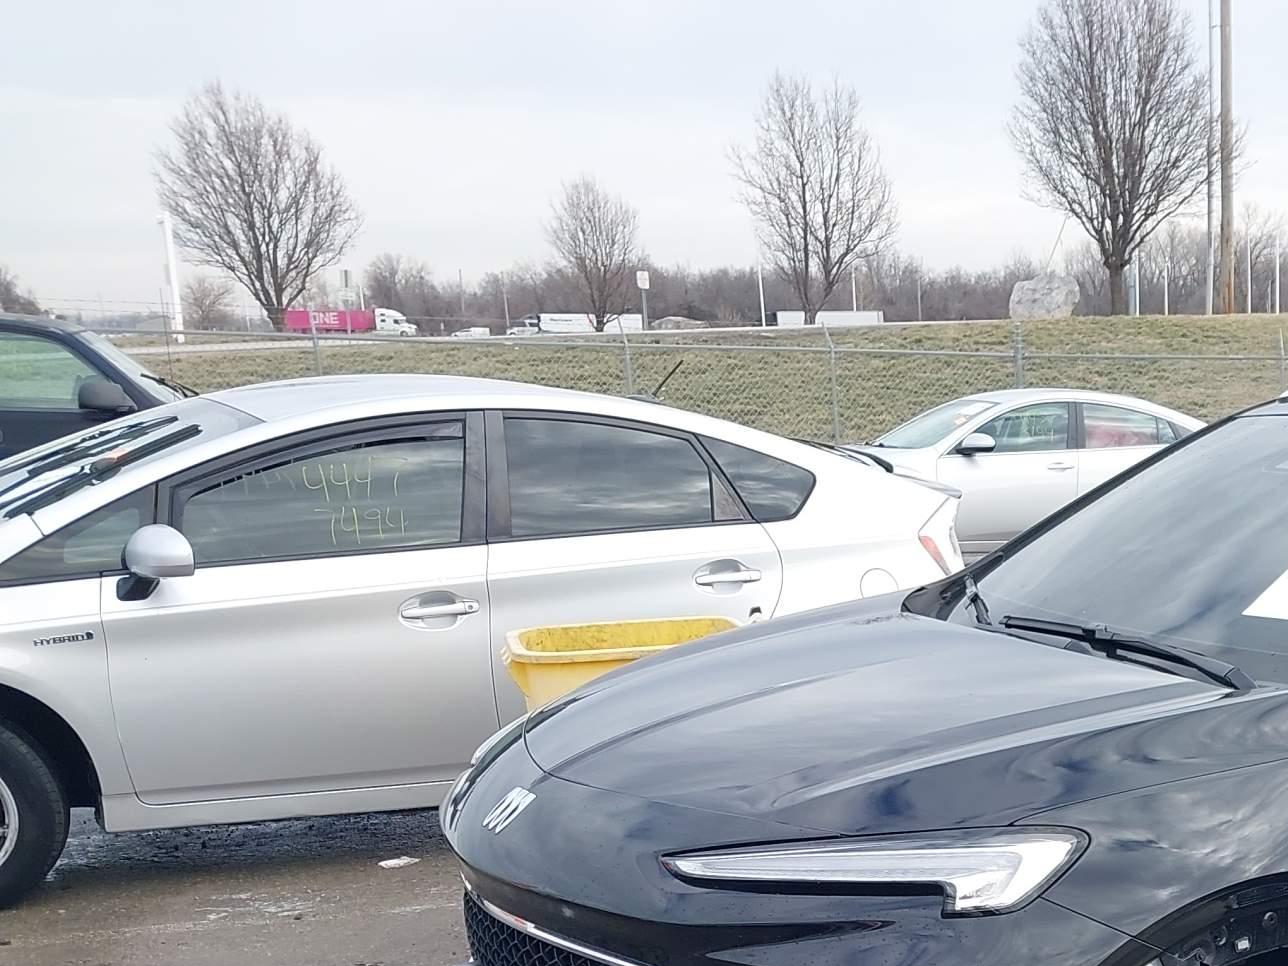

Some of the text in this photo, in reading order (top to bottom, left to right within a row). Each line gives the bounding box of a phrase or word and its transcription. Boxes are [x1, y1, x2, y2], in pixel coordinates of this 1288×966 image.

[309, 312, 340, 324] ONE
[313, 506, 409, 545] 7494
[33, 633, 85, 647] HYBRID
